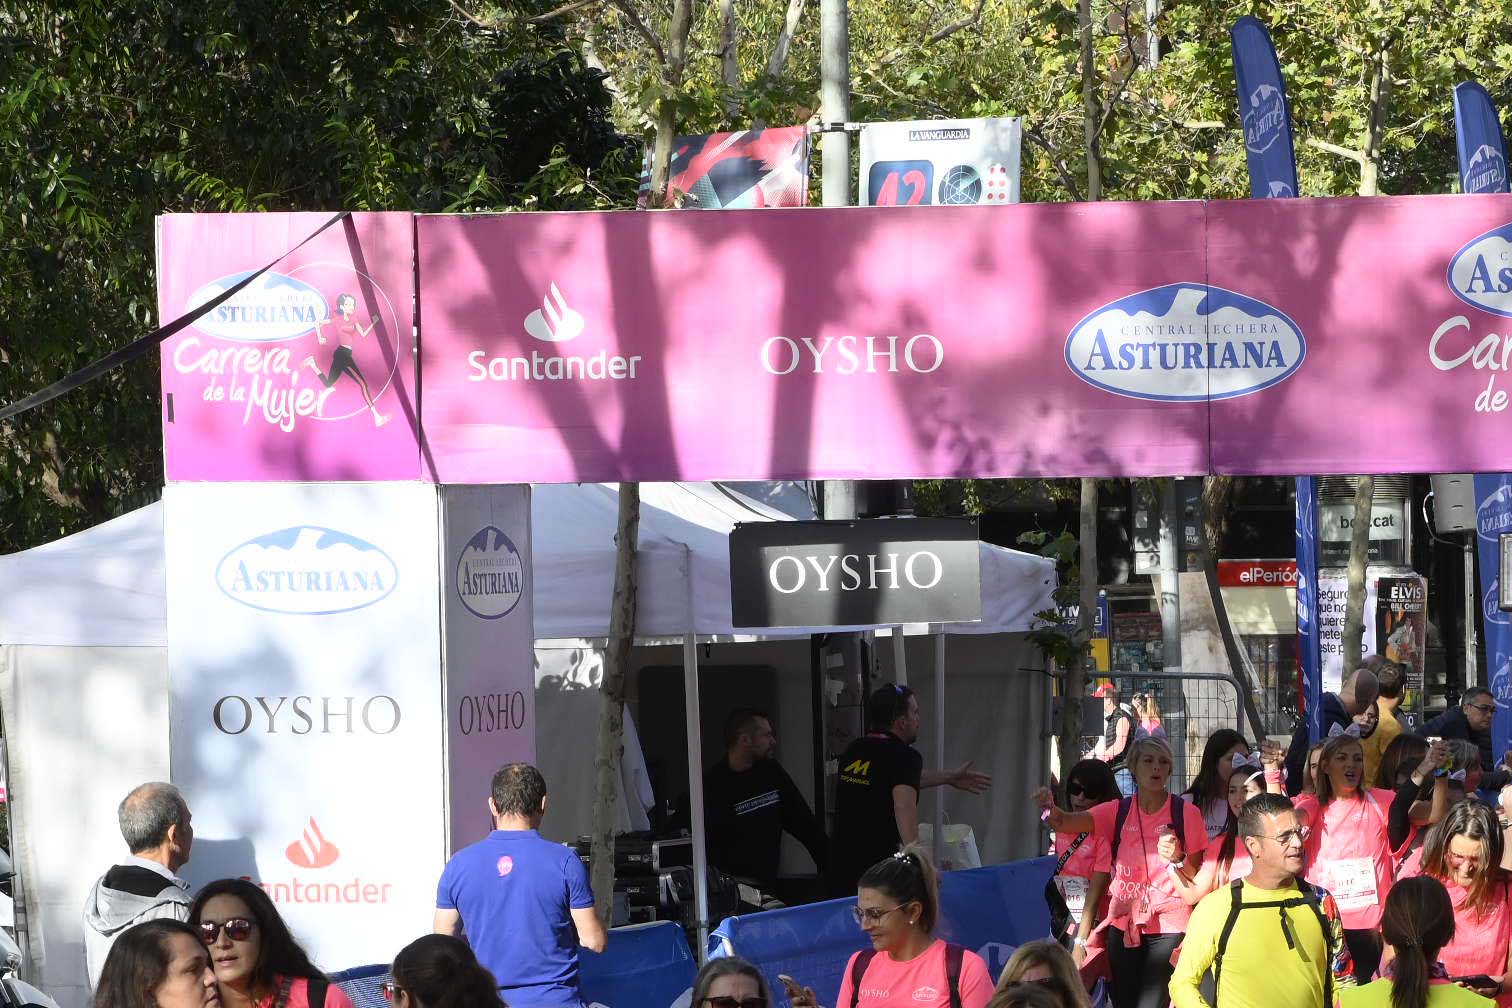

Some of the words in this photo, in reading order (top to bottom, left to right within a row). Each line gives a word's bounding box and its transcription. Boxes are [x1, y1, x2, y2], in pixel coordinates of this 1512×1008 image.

[909, 130, 921, 141] LA
[922, 129, 970, 141] VANGUARDIA
[1120, 322, 1198, 336] CENTRAL
[1205, 321, 1279, 335] LECHERA
[174, 336, 294, 374] Carrera
[466, 349, 642, 382] Santander
[759, 333, 946, 377] OYSHO
[1083, 328, 1287, 371] ASTURIANA
[203, 377, 225, 402] de
[229, 376, 246, 401] la
[243, 368, 336, 433] Mujer
[1474, 373, 1509, 412] de
[231, 560, 385, 593] ASTURIANA
[461, 562, 520, 597] ASTURIANA
[768, 550, 944, 594] OYSHO
[1391, 586, 1422, 599] ELVIS
[212, 694, 402, 735] OYSHO
[459, 690, 526, 736] OYSHO
